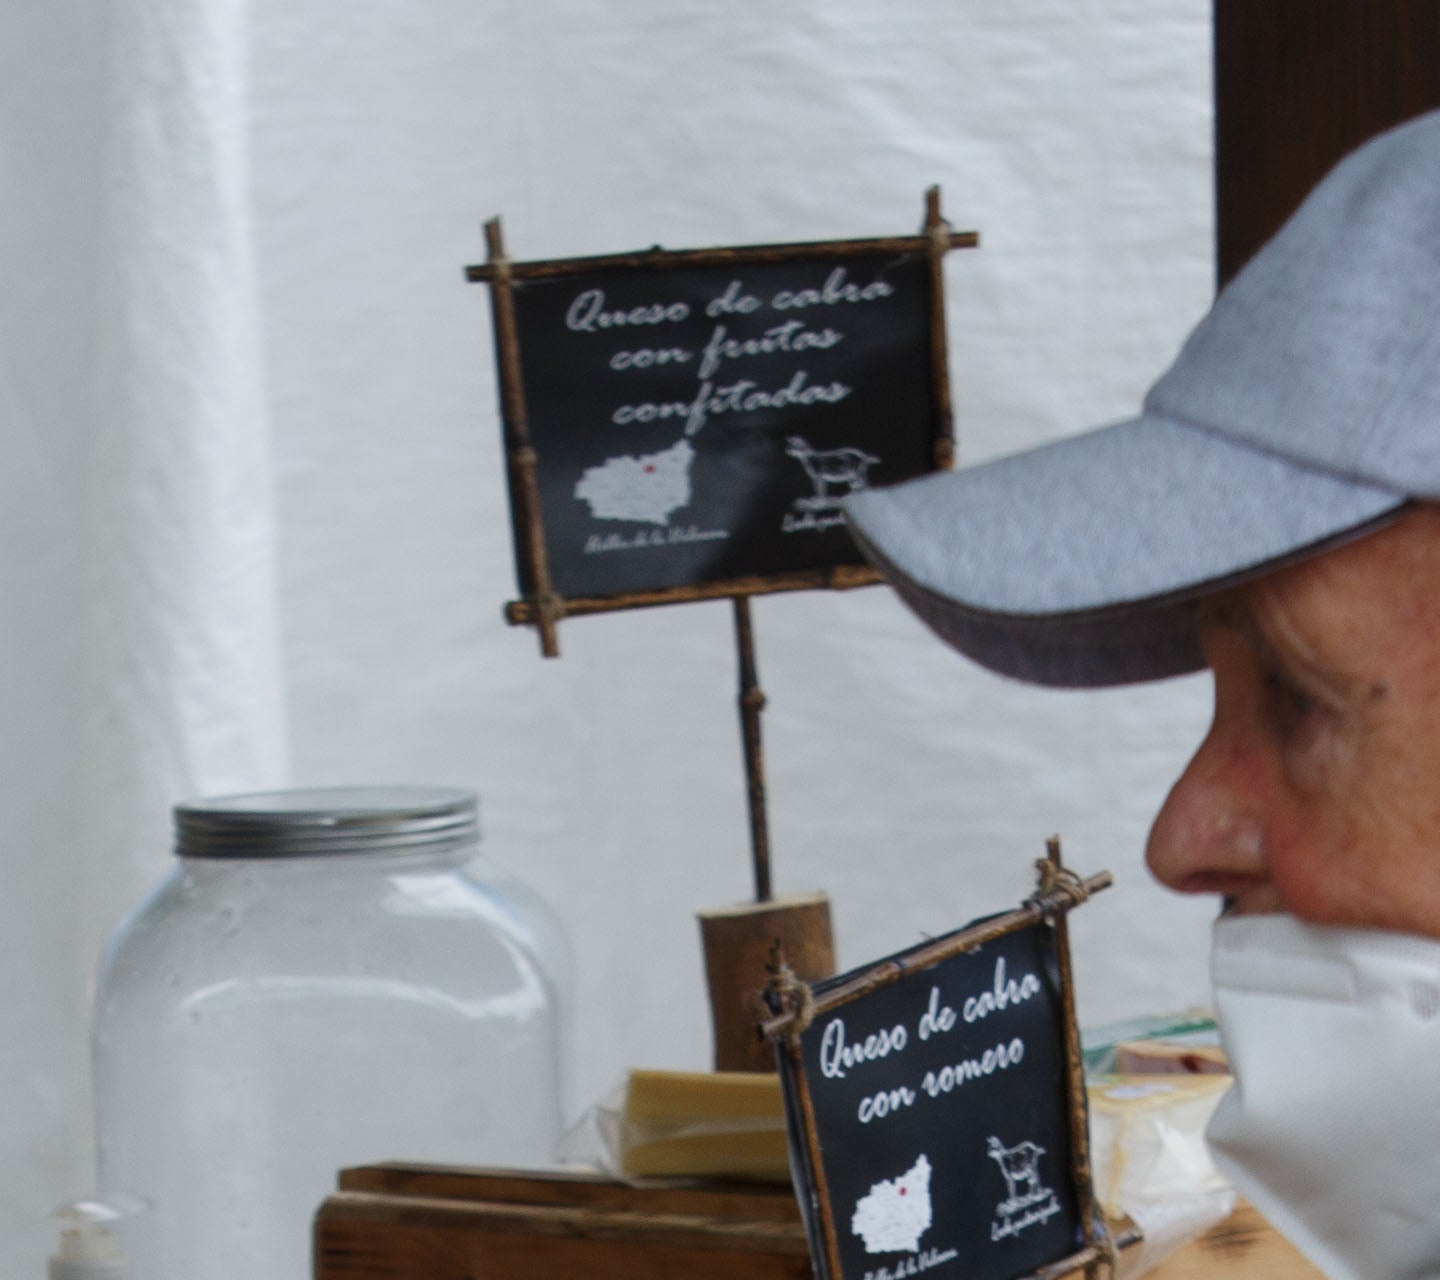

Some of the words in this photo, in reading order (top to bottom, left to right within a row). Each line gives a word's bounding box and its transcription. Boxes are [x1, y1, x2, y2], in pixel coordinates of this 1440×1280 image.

[565, 288, 691, 332] Queso
[705, 279, 762, 318] de
[771, 266, 896, 310] cabra
[609, 348, 695, 371] con
[697, 320, 845, 380] frutas
[612, 370, 853, 436] confitadas
[819, 1018, 909, 1079] Queso
[918, 986, 958, 1041] de
[963, 956, 1042, 1023] cabra
[858, 1086, 916, 1124] con
[921, 1037, 1025, 1098] romero
